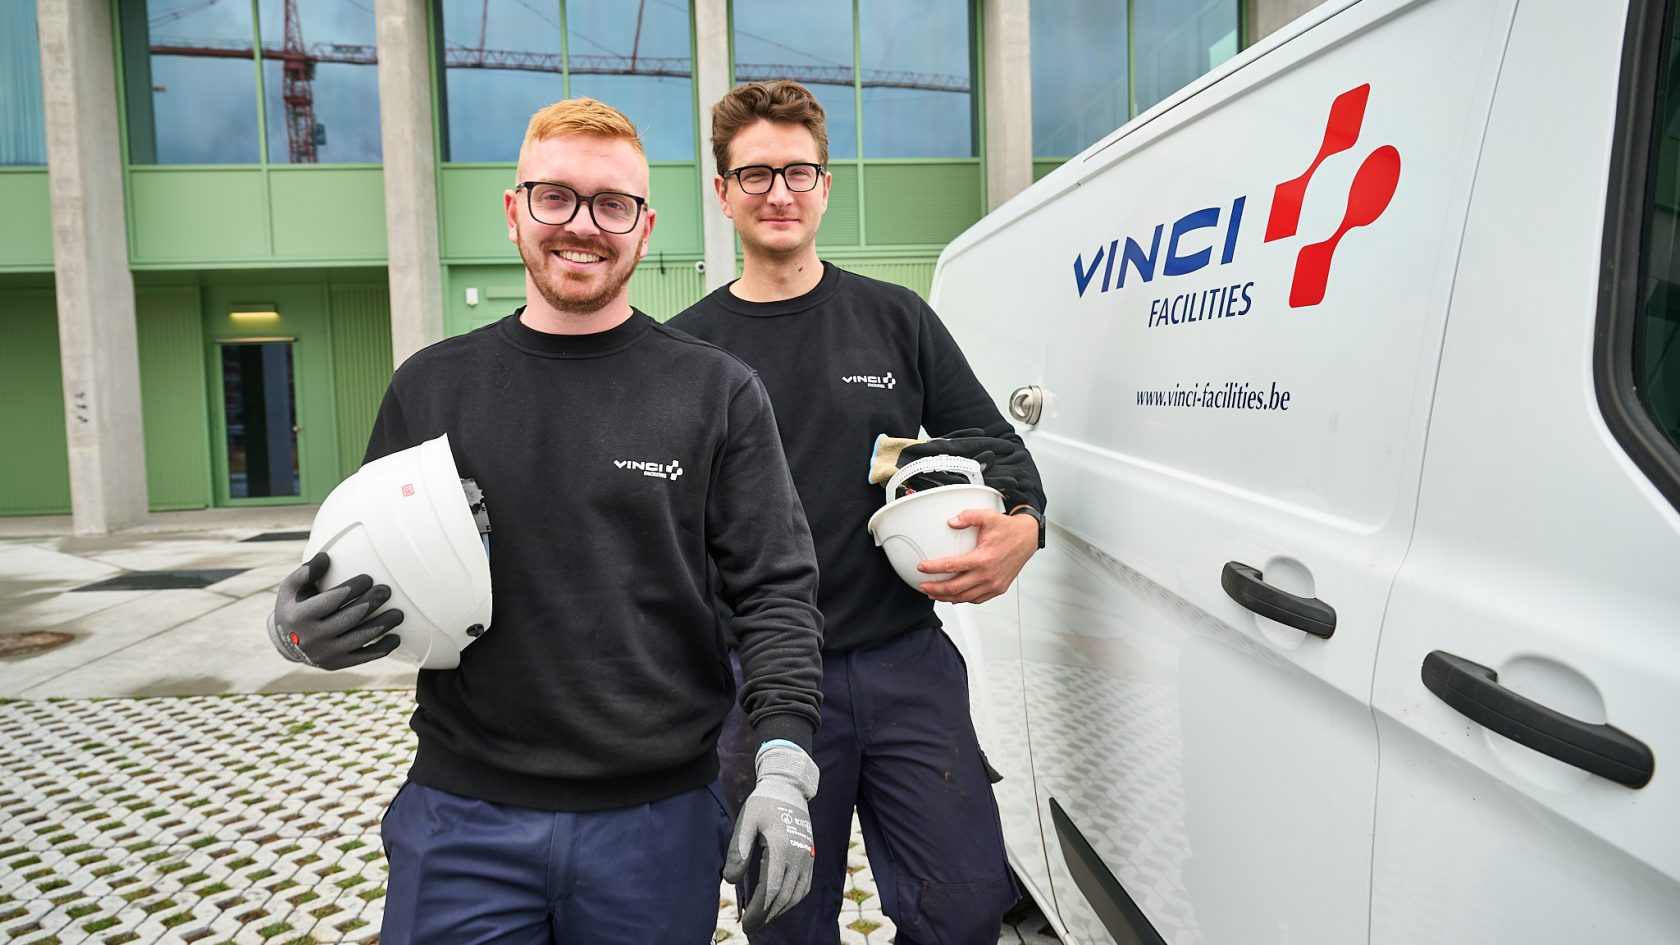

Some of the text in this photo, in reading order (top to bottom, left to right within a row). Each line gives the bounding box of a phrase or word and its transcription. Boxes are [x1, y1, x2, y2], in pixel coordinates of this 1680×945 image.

[1073, 195, 1247, 299] VINCI
[1148, 281, 1254, 328] FACILITIES
[842, 375, 881, 384] VINCI
[1136, 382, 1290, 411] www.vinci-facilities.be
[613, 460, 663, 472] VINCI
